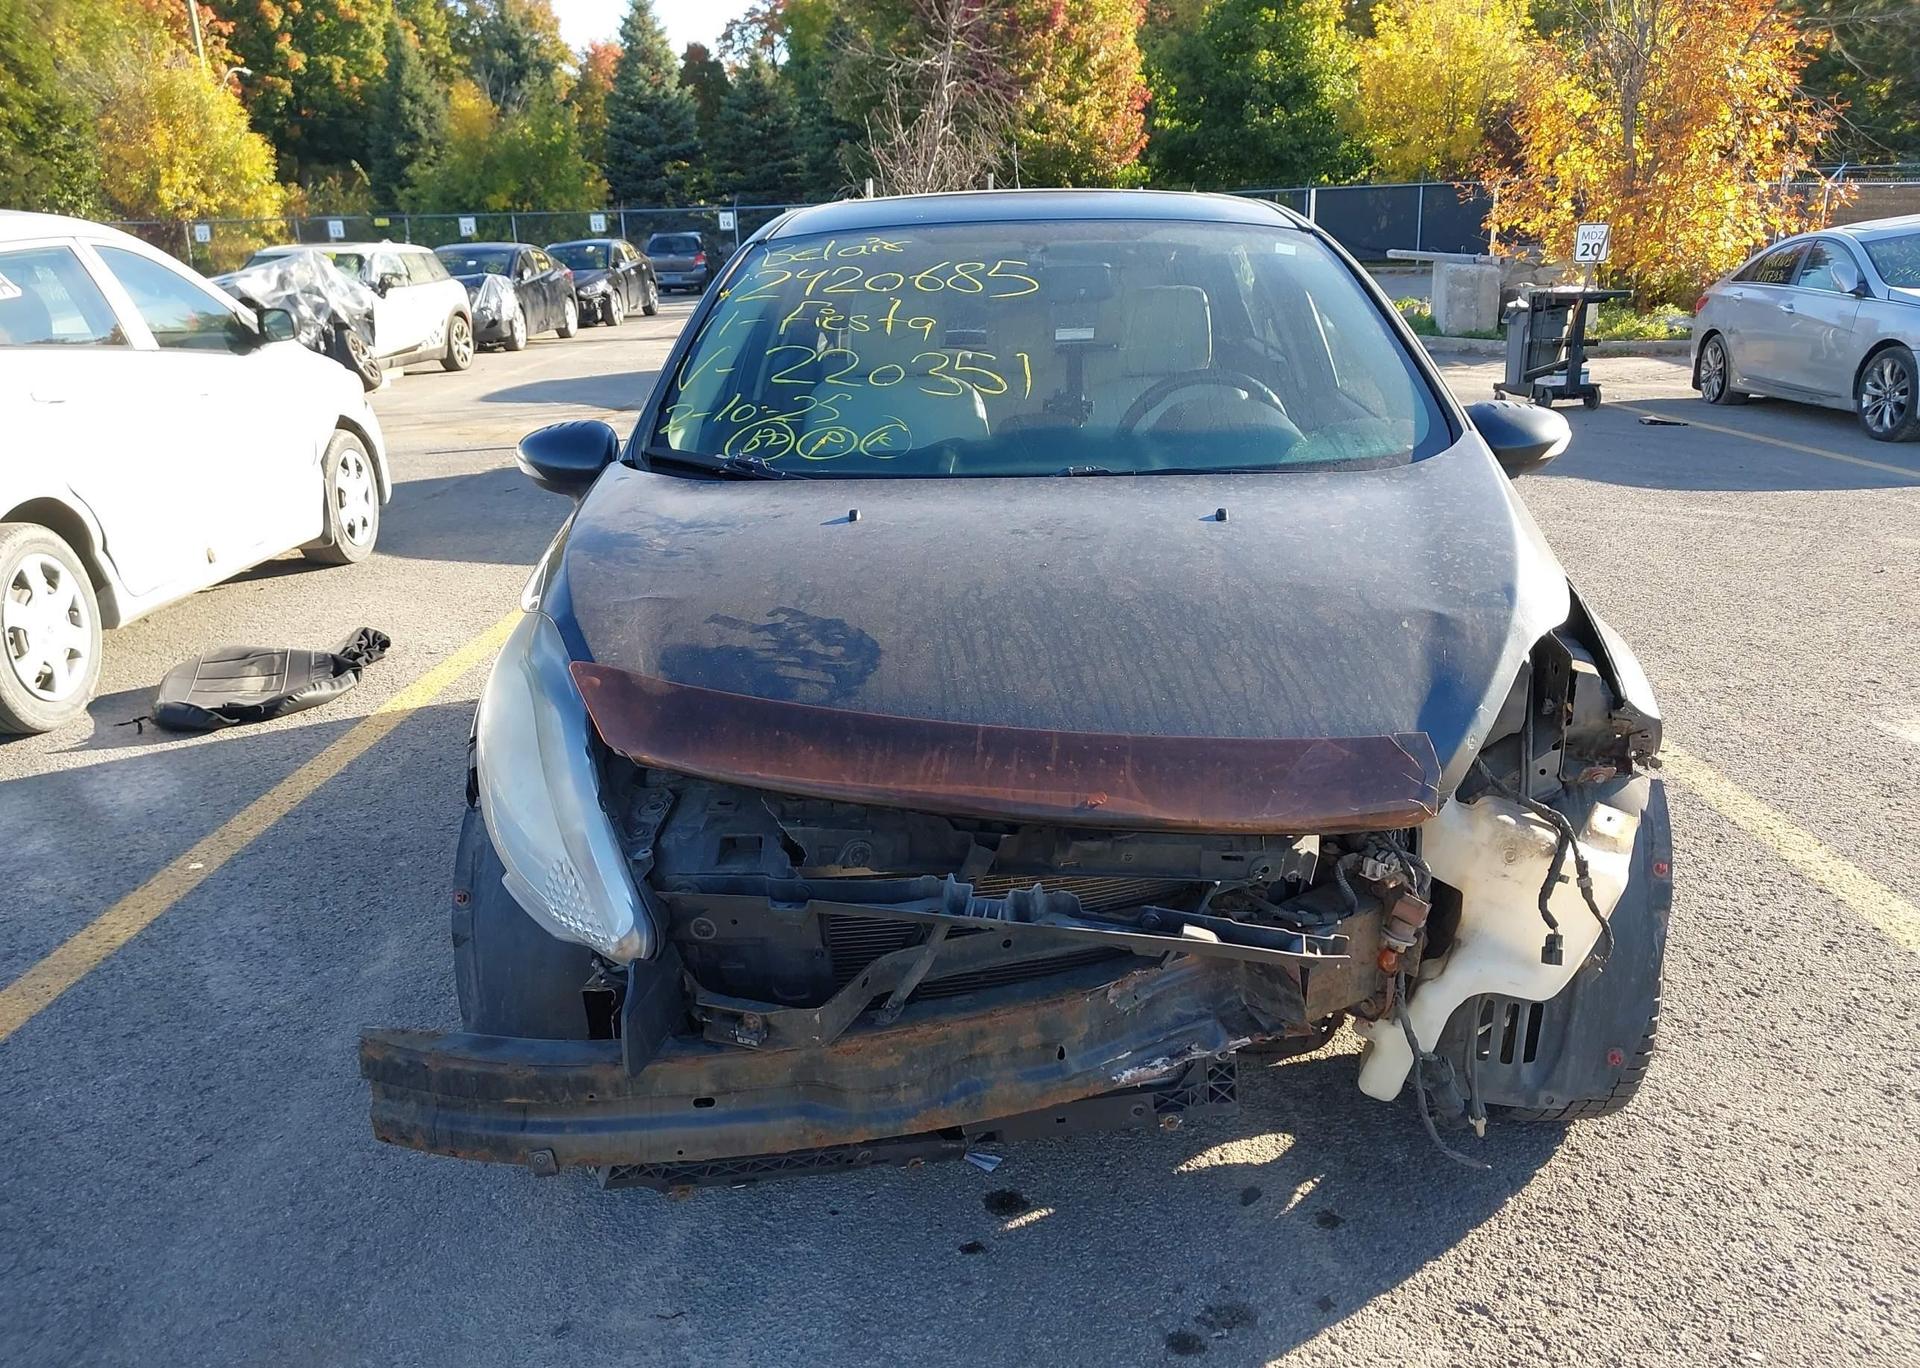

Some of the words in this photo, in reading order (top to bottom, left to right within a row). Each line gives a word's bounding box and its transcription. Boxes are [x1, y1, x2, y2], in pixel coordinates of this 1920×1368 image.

[1580, 242, 1601, 257] 20
[1582, 230, 1604, 240] MDZ
[779, 297, 936, 342] Fiesta
[766, 346, 1032, 399] 220351
